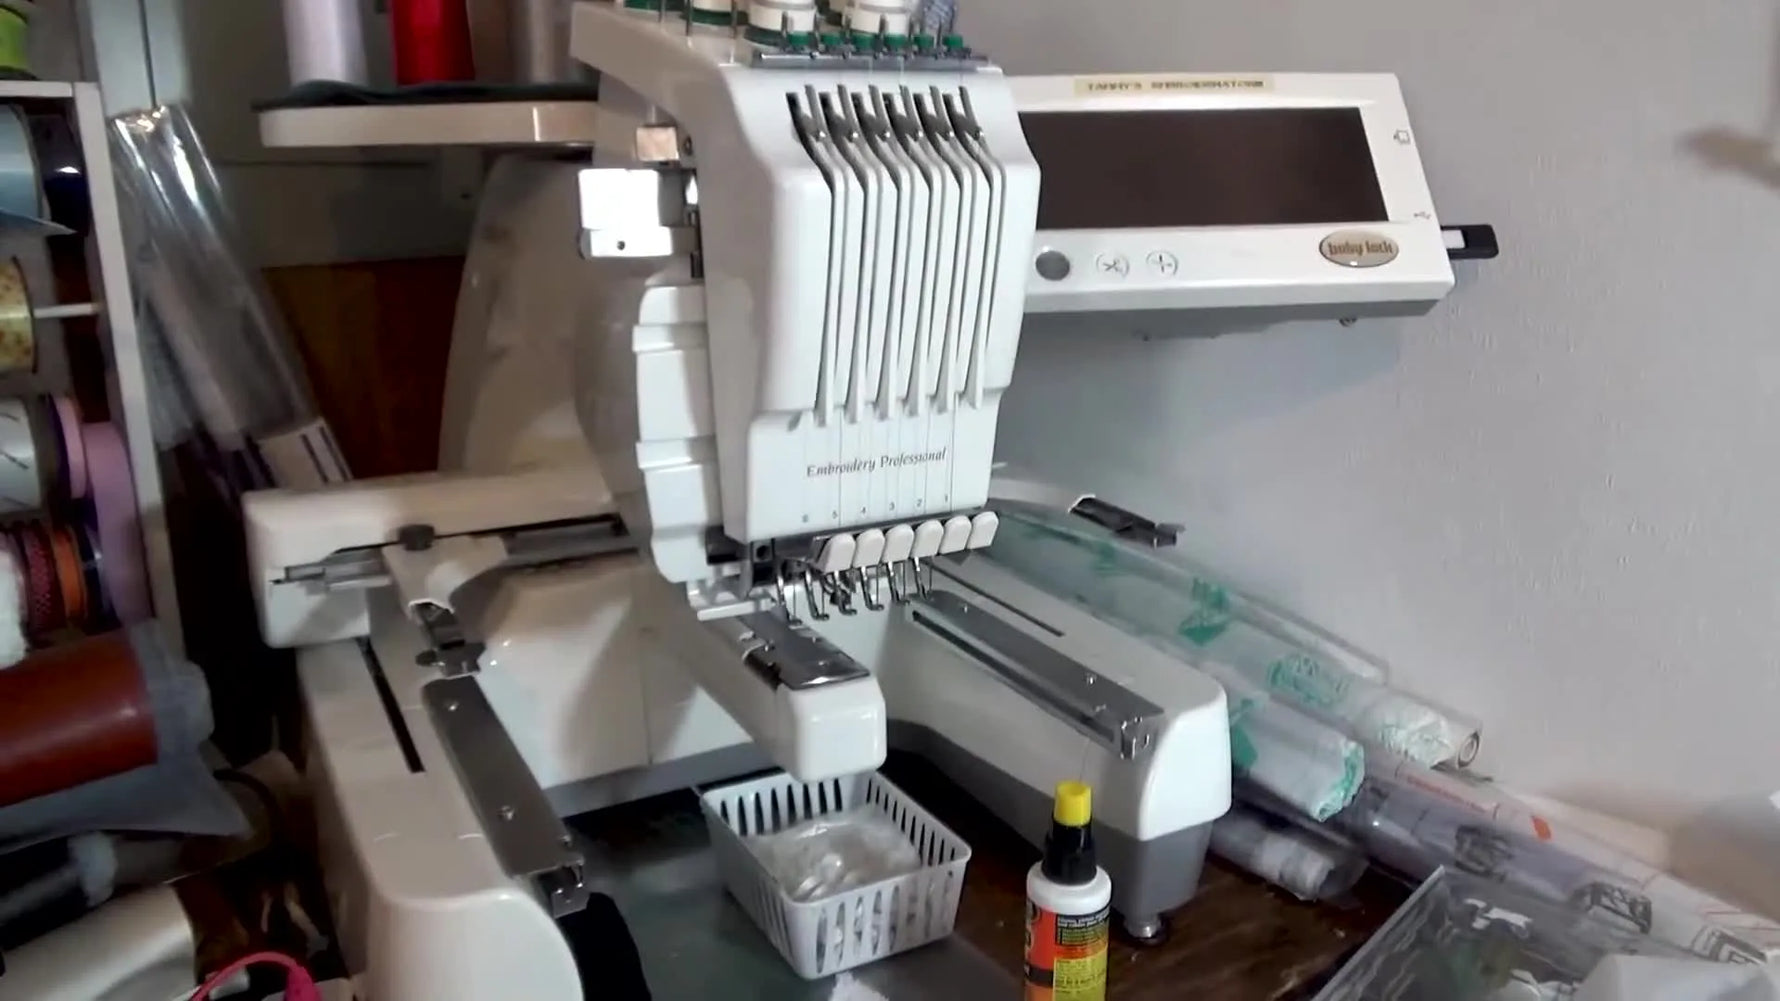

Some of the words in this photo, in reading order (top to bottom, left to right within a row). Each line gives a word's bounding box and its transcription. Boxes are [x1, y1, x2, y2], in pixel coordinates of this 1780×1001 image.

[807, 458, 876, 477] Embroidery
[880, 446, 946, 468] Professional
[861, 506, 867, 515] 4
[889, 502, 896, 511] 3
[917, 498, 923, 507] 2
